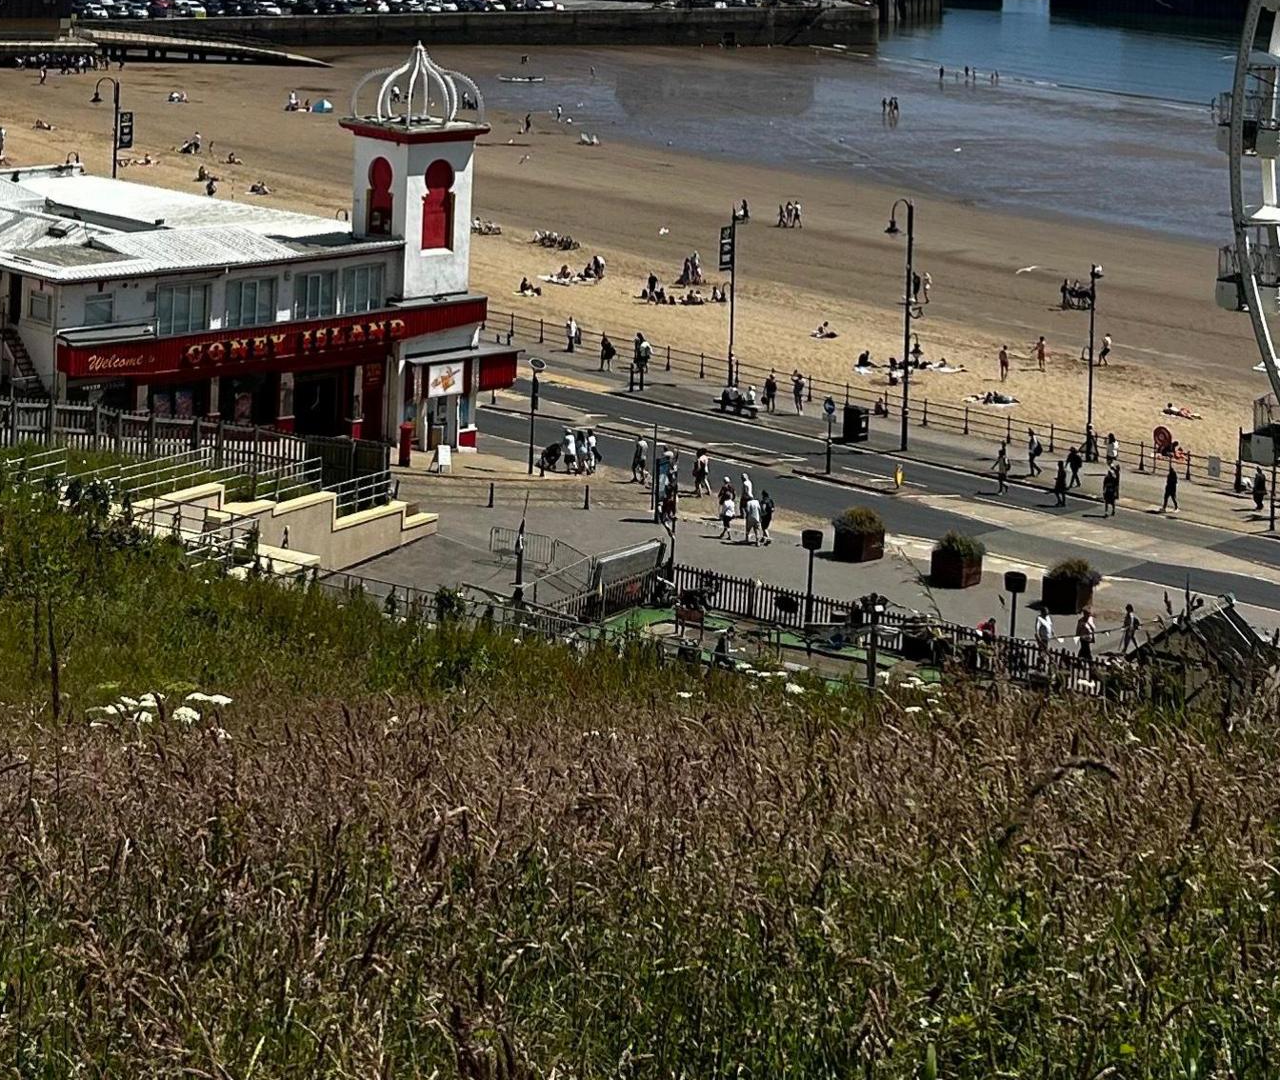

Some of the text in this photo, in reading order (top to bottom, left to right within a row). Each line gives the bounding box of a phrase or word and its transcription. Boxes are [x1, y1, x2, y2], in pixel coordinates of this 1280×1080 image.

[187, 318, 406, 364] CONEY ISLAND
[88, 354, 143, 372] Welcome
